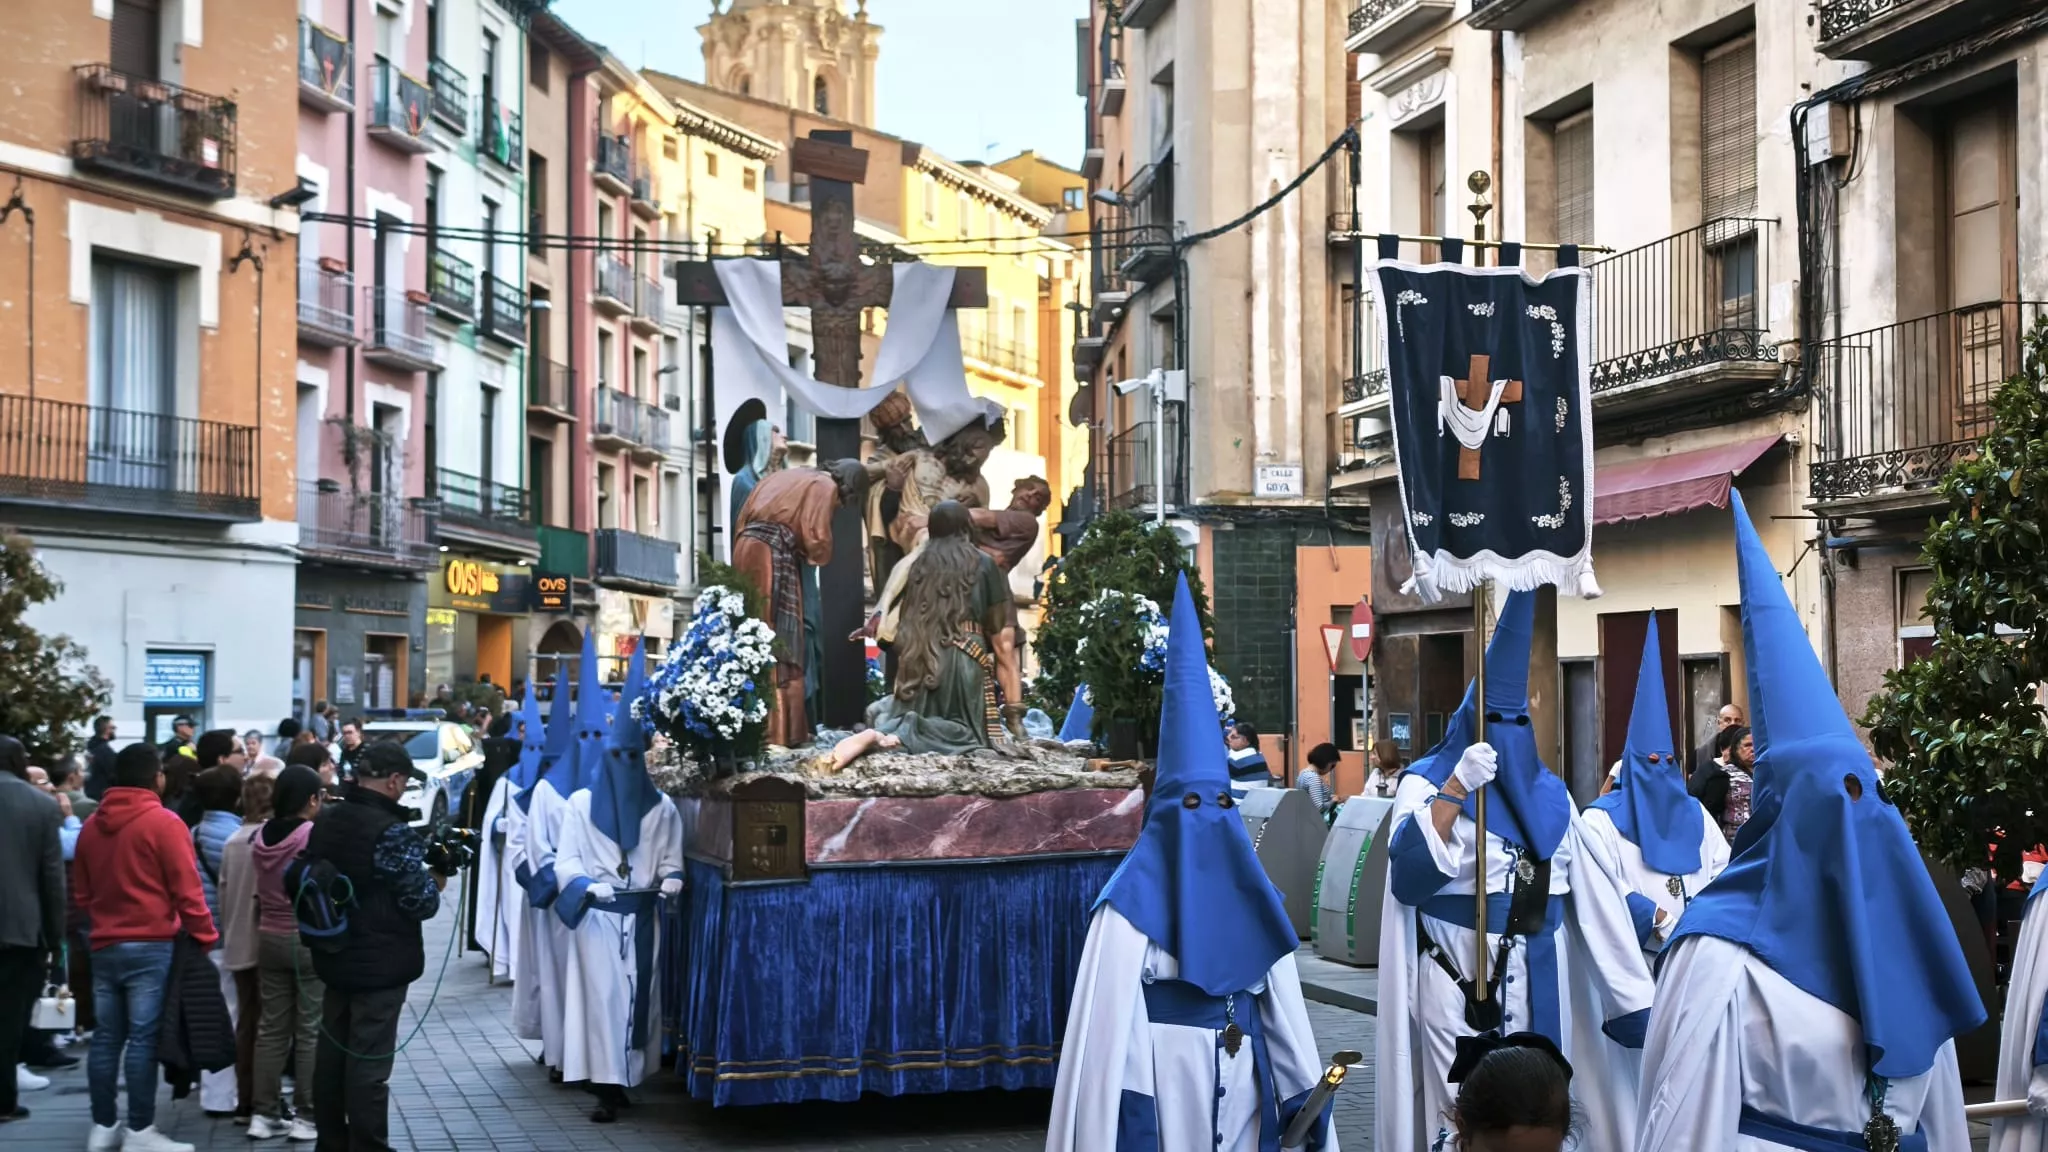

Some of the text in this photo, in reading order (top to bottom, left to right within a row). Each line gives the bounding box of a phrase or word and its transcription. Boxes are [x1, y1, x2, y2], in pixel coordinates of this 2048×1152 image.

[1271, 469, 1293, 477] CALLE
[1266, 483, 1289, 492] GOYA
[448, 560, 477, 595] OVS
[539, 578, 567, 591] OVS
